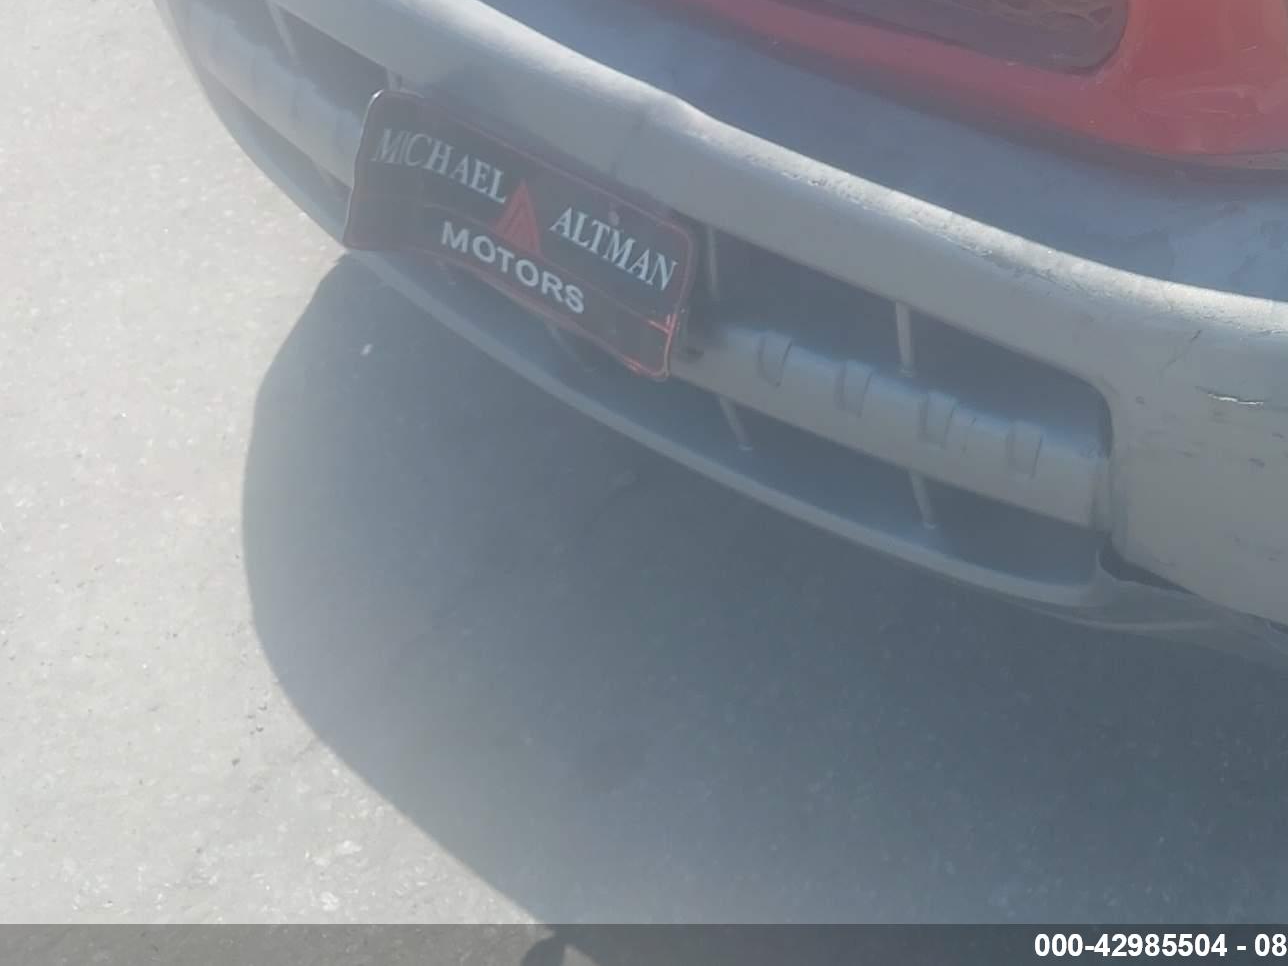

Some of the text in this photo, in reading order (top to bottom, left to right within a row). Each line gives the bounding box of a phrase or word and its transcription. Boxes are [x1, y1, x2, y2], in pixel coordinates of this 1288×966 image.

[371, 129, 678, 290] MICHAEL ALTMAN
[441, 221, 585, 314] MOTORS
